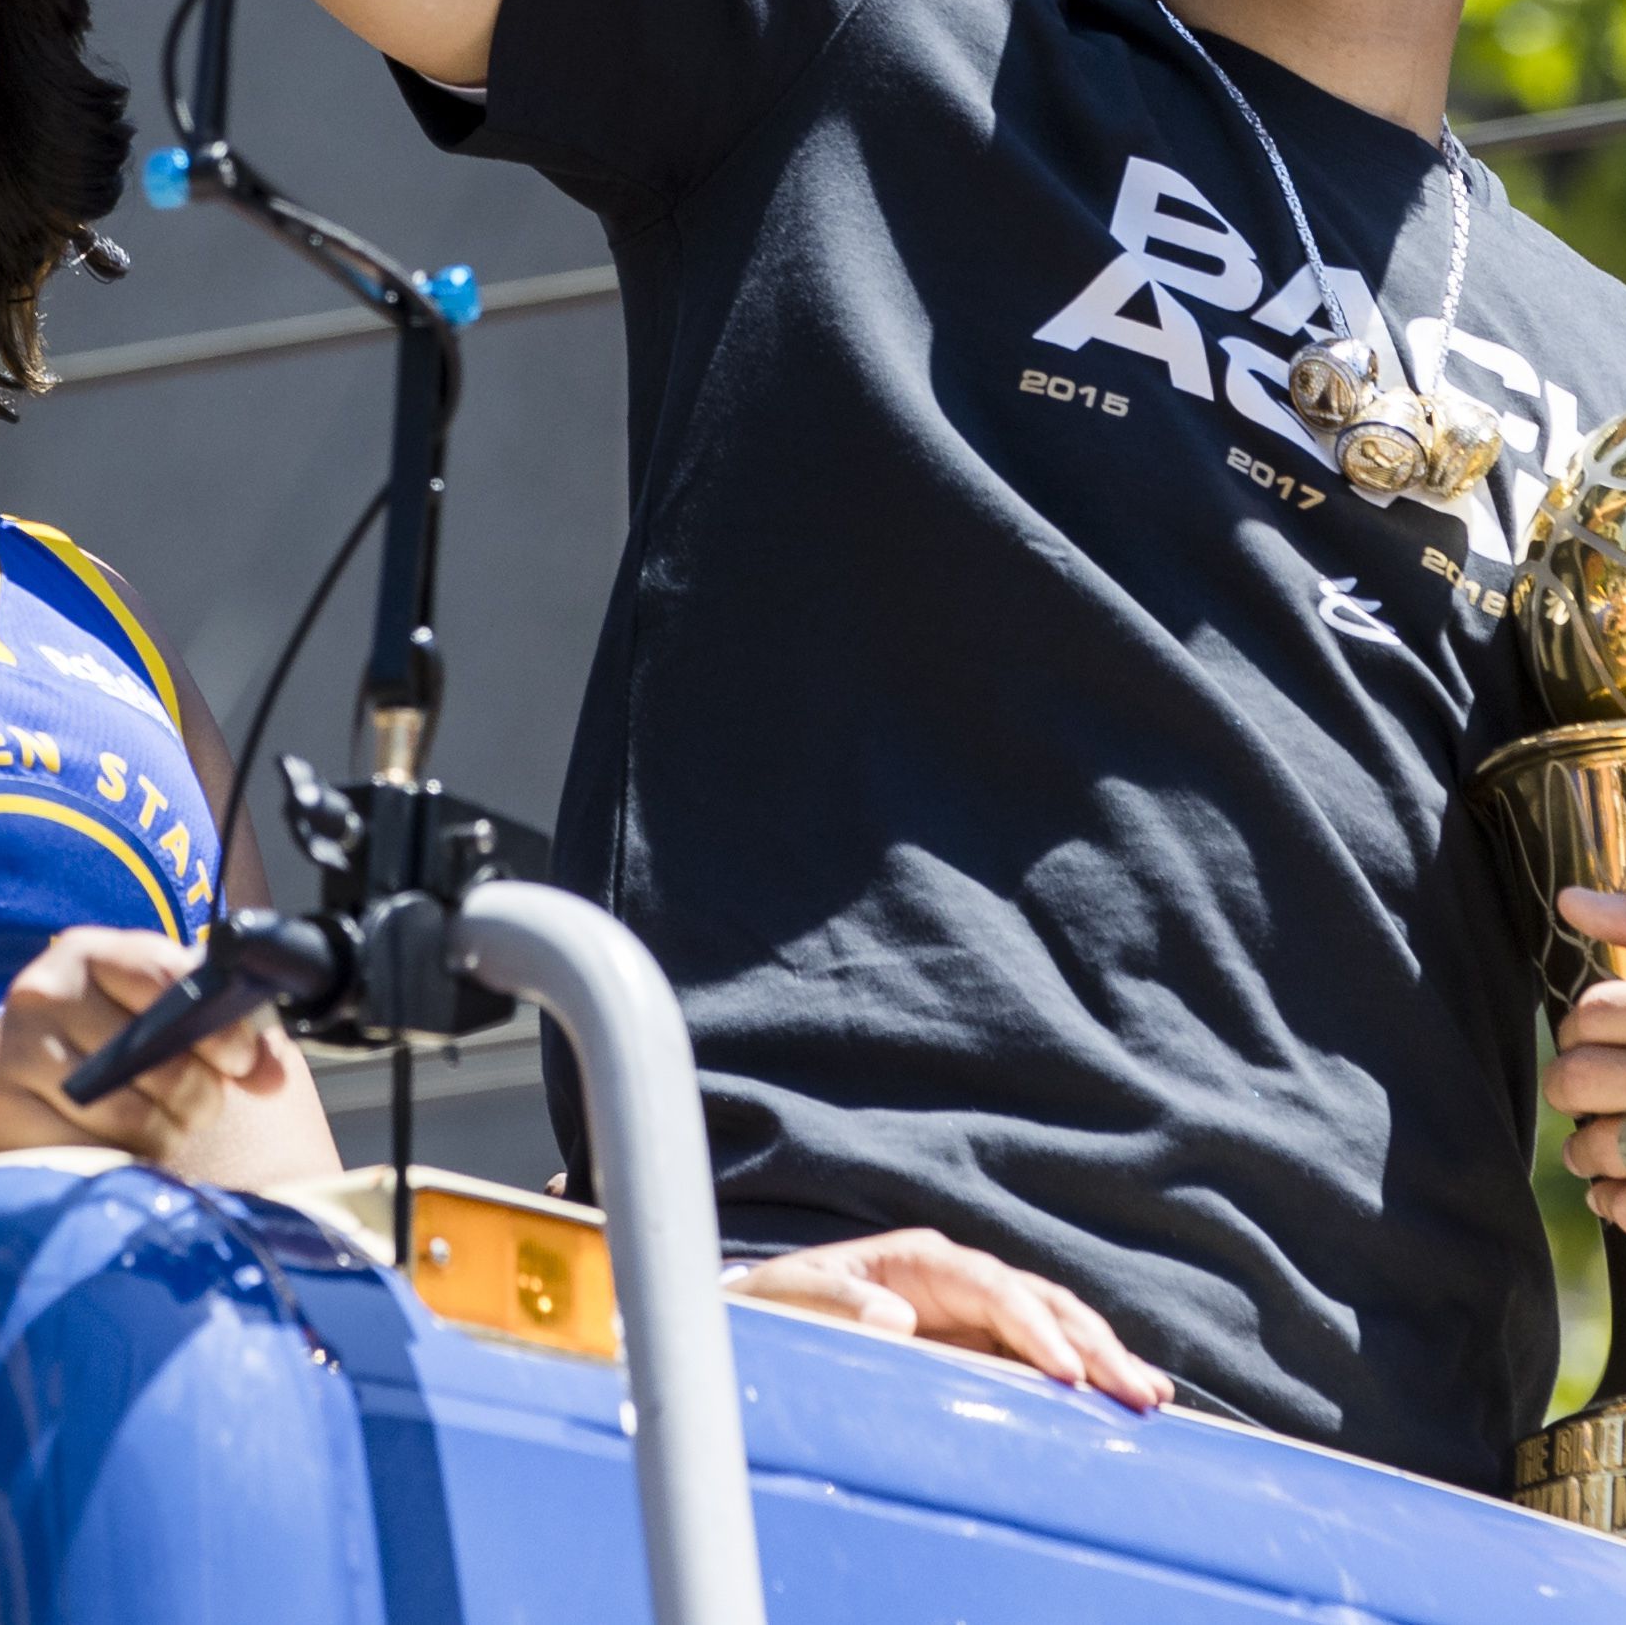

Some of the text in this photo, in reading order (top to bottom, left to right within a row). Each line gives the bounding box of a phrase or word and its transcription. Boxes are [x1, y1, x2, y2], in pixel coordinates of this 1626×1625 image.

[1019, 369, 1508, 619] 2015 2017 2018
[1515, 1432, 1550, 1487] THE
